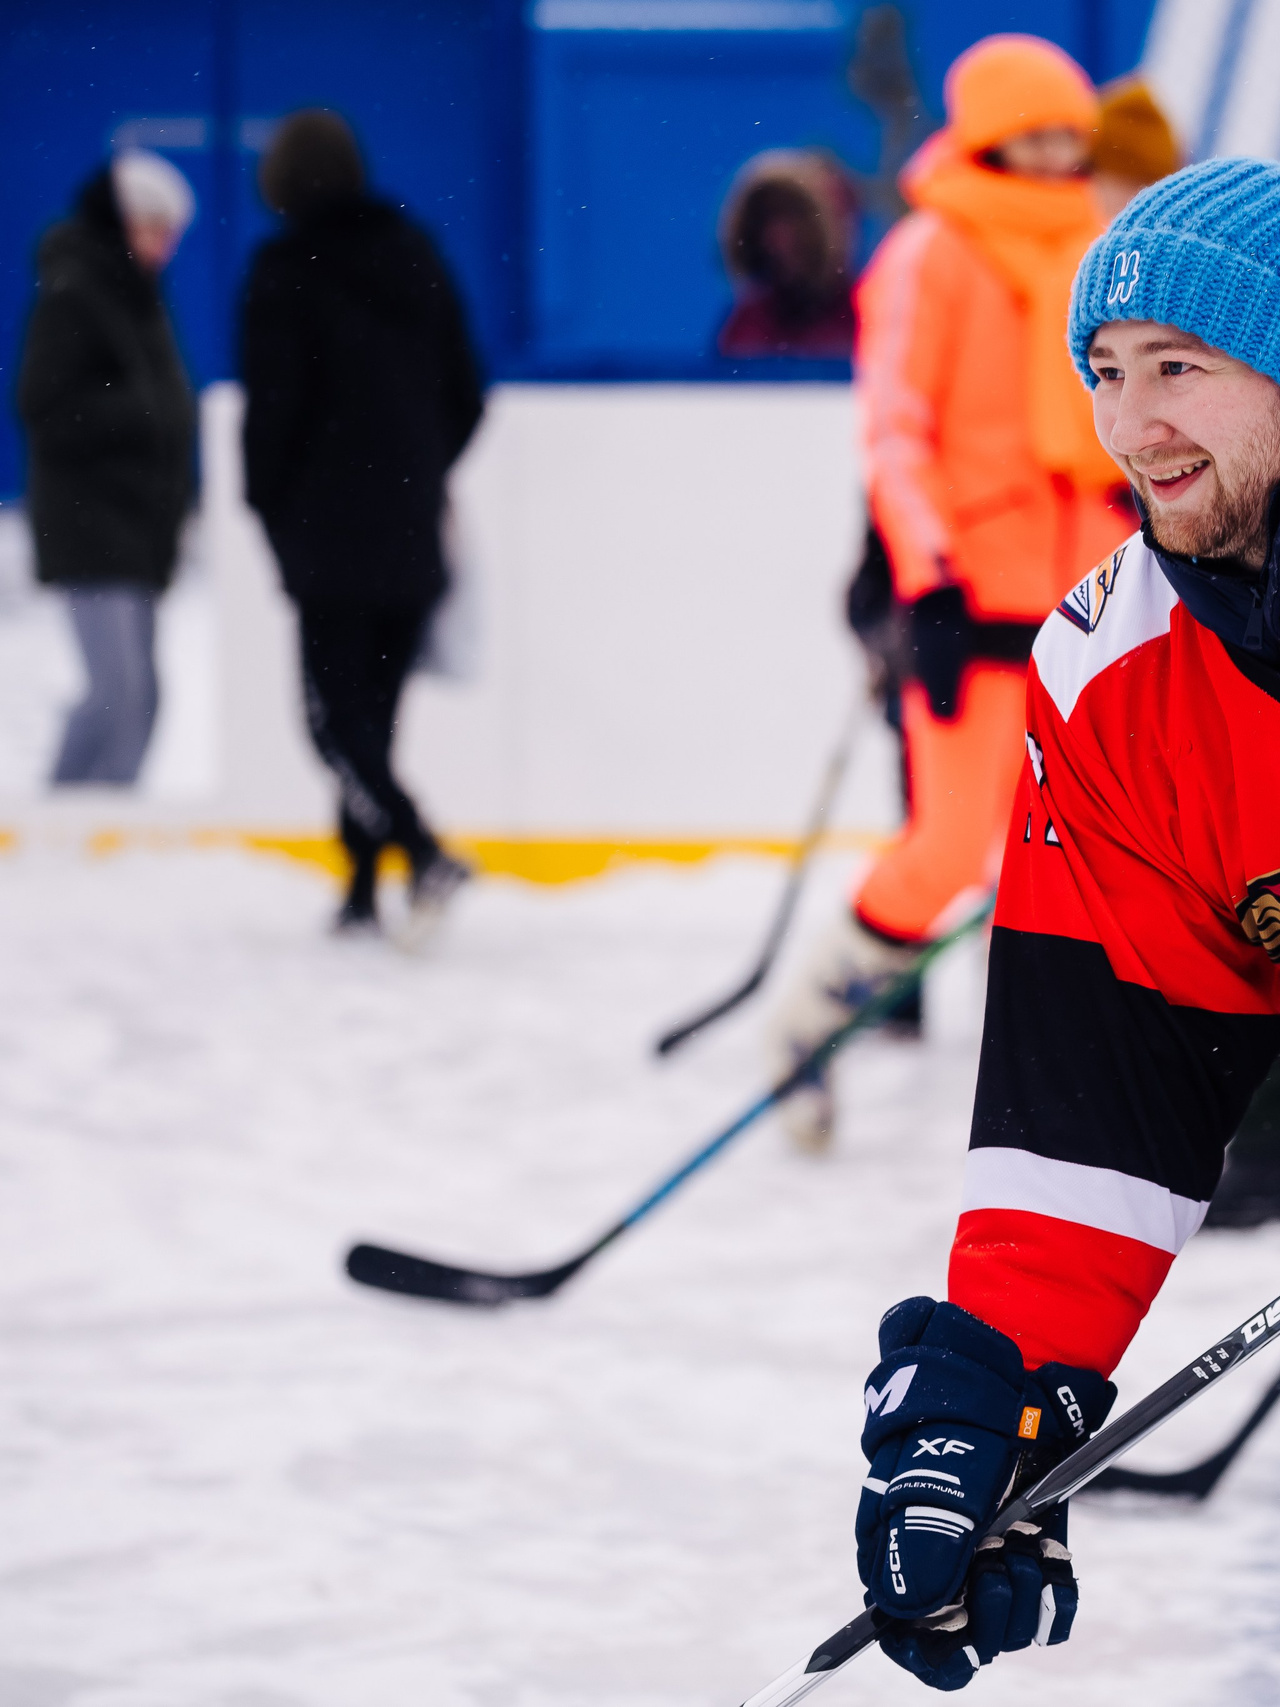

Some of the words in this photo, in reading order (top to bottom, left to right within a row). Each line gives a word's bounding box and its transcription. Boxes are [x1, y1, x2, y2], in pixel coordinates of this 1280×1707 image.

[1057, 1385, 1085, 1437] CCM
[912, 1437, 975, 1458] XF
[903, 1481, 965, 1499] FLEXTHUMB
[889, 1528, 907, 1595] CCM
